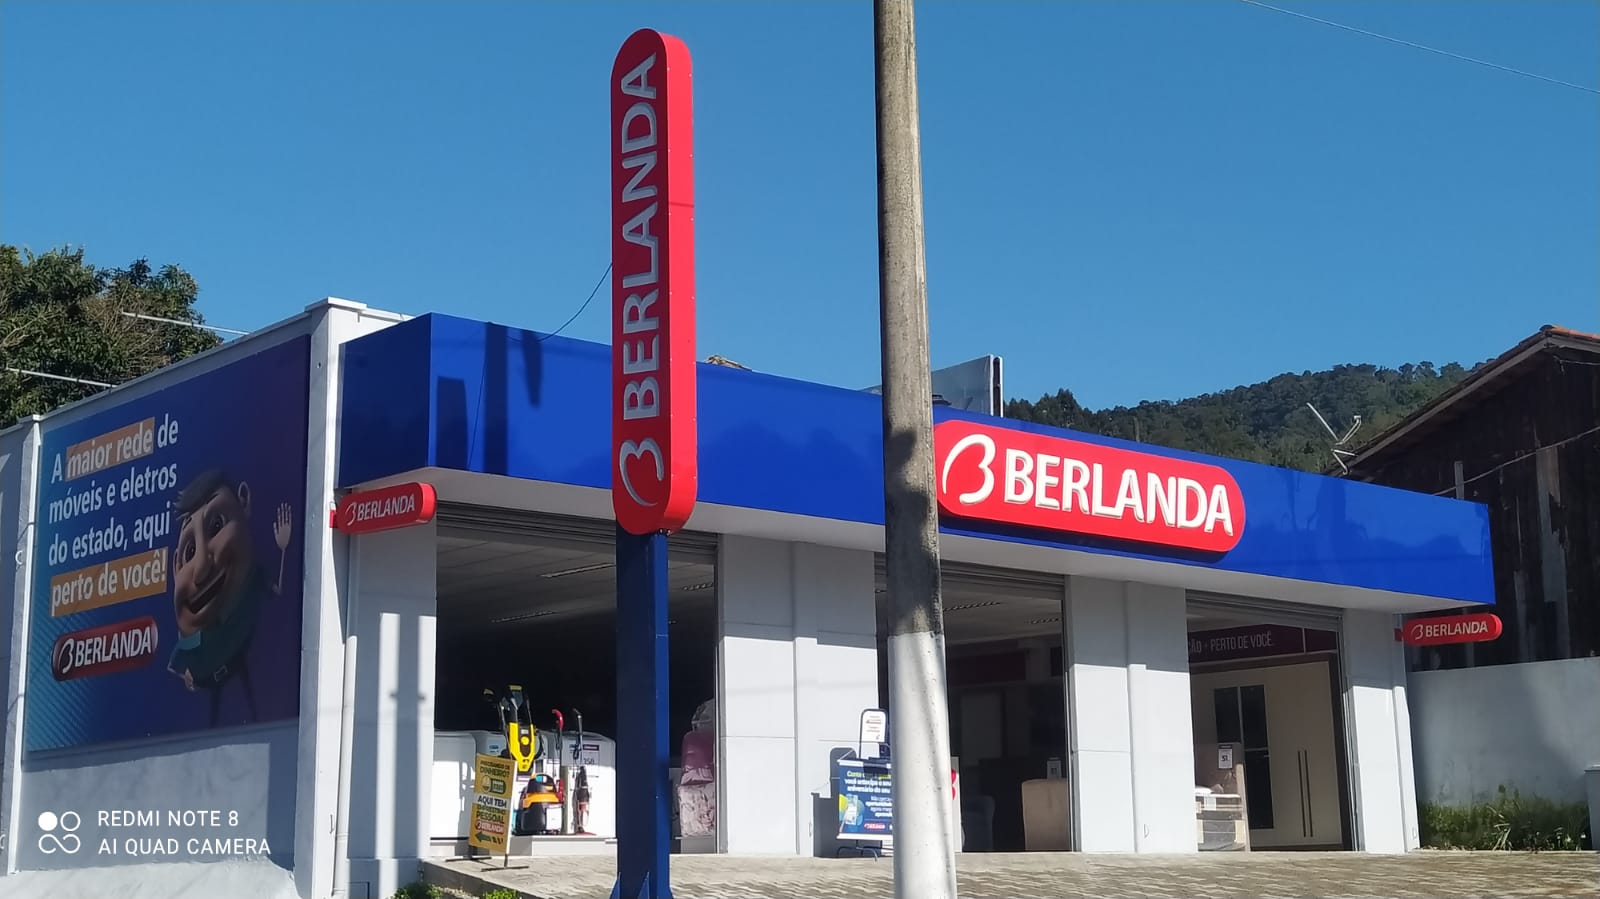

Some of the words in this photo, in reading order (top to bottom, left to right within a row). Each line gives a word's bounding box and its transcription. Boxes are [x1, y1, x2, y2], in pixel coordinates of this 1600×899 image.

[620, 51, 660, 420] BERLANDA
[51, 453, 63, 484] A
[67, 440, 112, 479] maior
[116, 421, 153, 462] rede
[157, 413, 178, 448] de
[49, 480, 102, 524] móveis
[106, 483, 116, 506] e
[120, 463, 177, 502] eletros
[357, 494, 415, 521] BERLANDA
[1004, 448, 1233, 536] BERLANDA
[49, 533, 68, 566] do
[72, 517, 128, 560] estado,
[133, 501, 171, 549] aqui
[51, 573, 94, 617] perto
[98, 562, 118, 597] de
[122, 549, 167, 591] você!
[74, 626, 151, 667] BERLANDA
[1210, 636, 1236, 652] PERTO
[1238, 635, 1248, 649] DE
[1250, 631, 1272, 648] VOCÊ
[1425, 621, 1488, 637] BERLANDA
[476, 810, 504, 824] PESSOAL
[478, 795, 493, 805] AQUI
[494, 798, 507, 808] TEM
